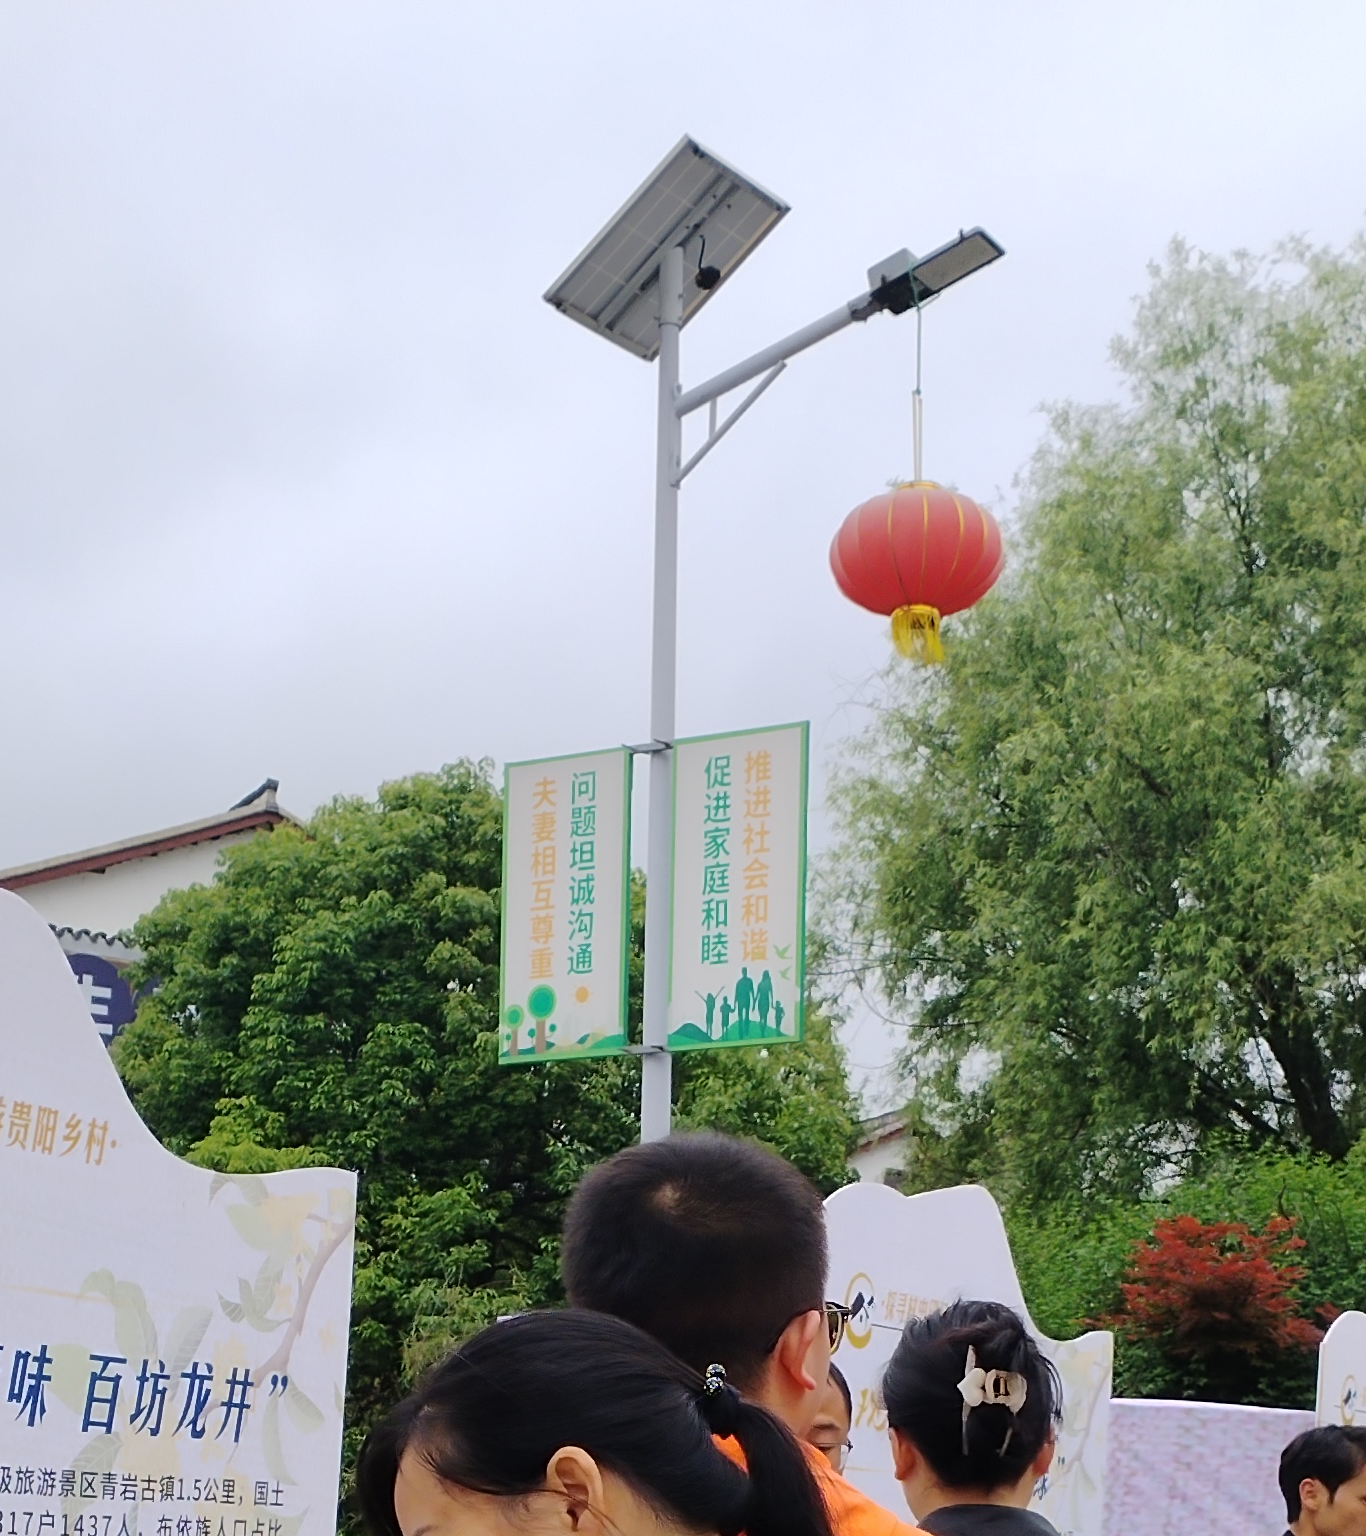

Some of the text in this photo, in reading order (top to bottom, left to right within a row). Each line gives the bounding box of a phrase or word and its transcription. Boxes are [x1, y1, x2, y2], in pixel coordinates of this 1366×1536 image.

[528, 776, 558, 981] 夫妻相互尊重
[566, 769, 597, 977] 问题坦诚沟通
[700, 753, 733, 966] 促进家庭和睦
[740, 749, 773, 963] 推进社会和谐
[81, 1353, 289, 1443] 百坊龙井”
